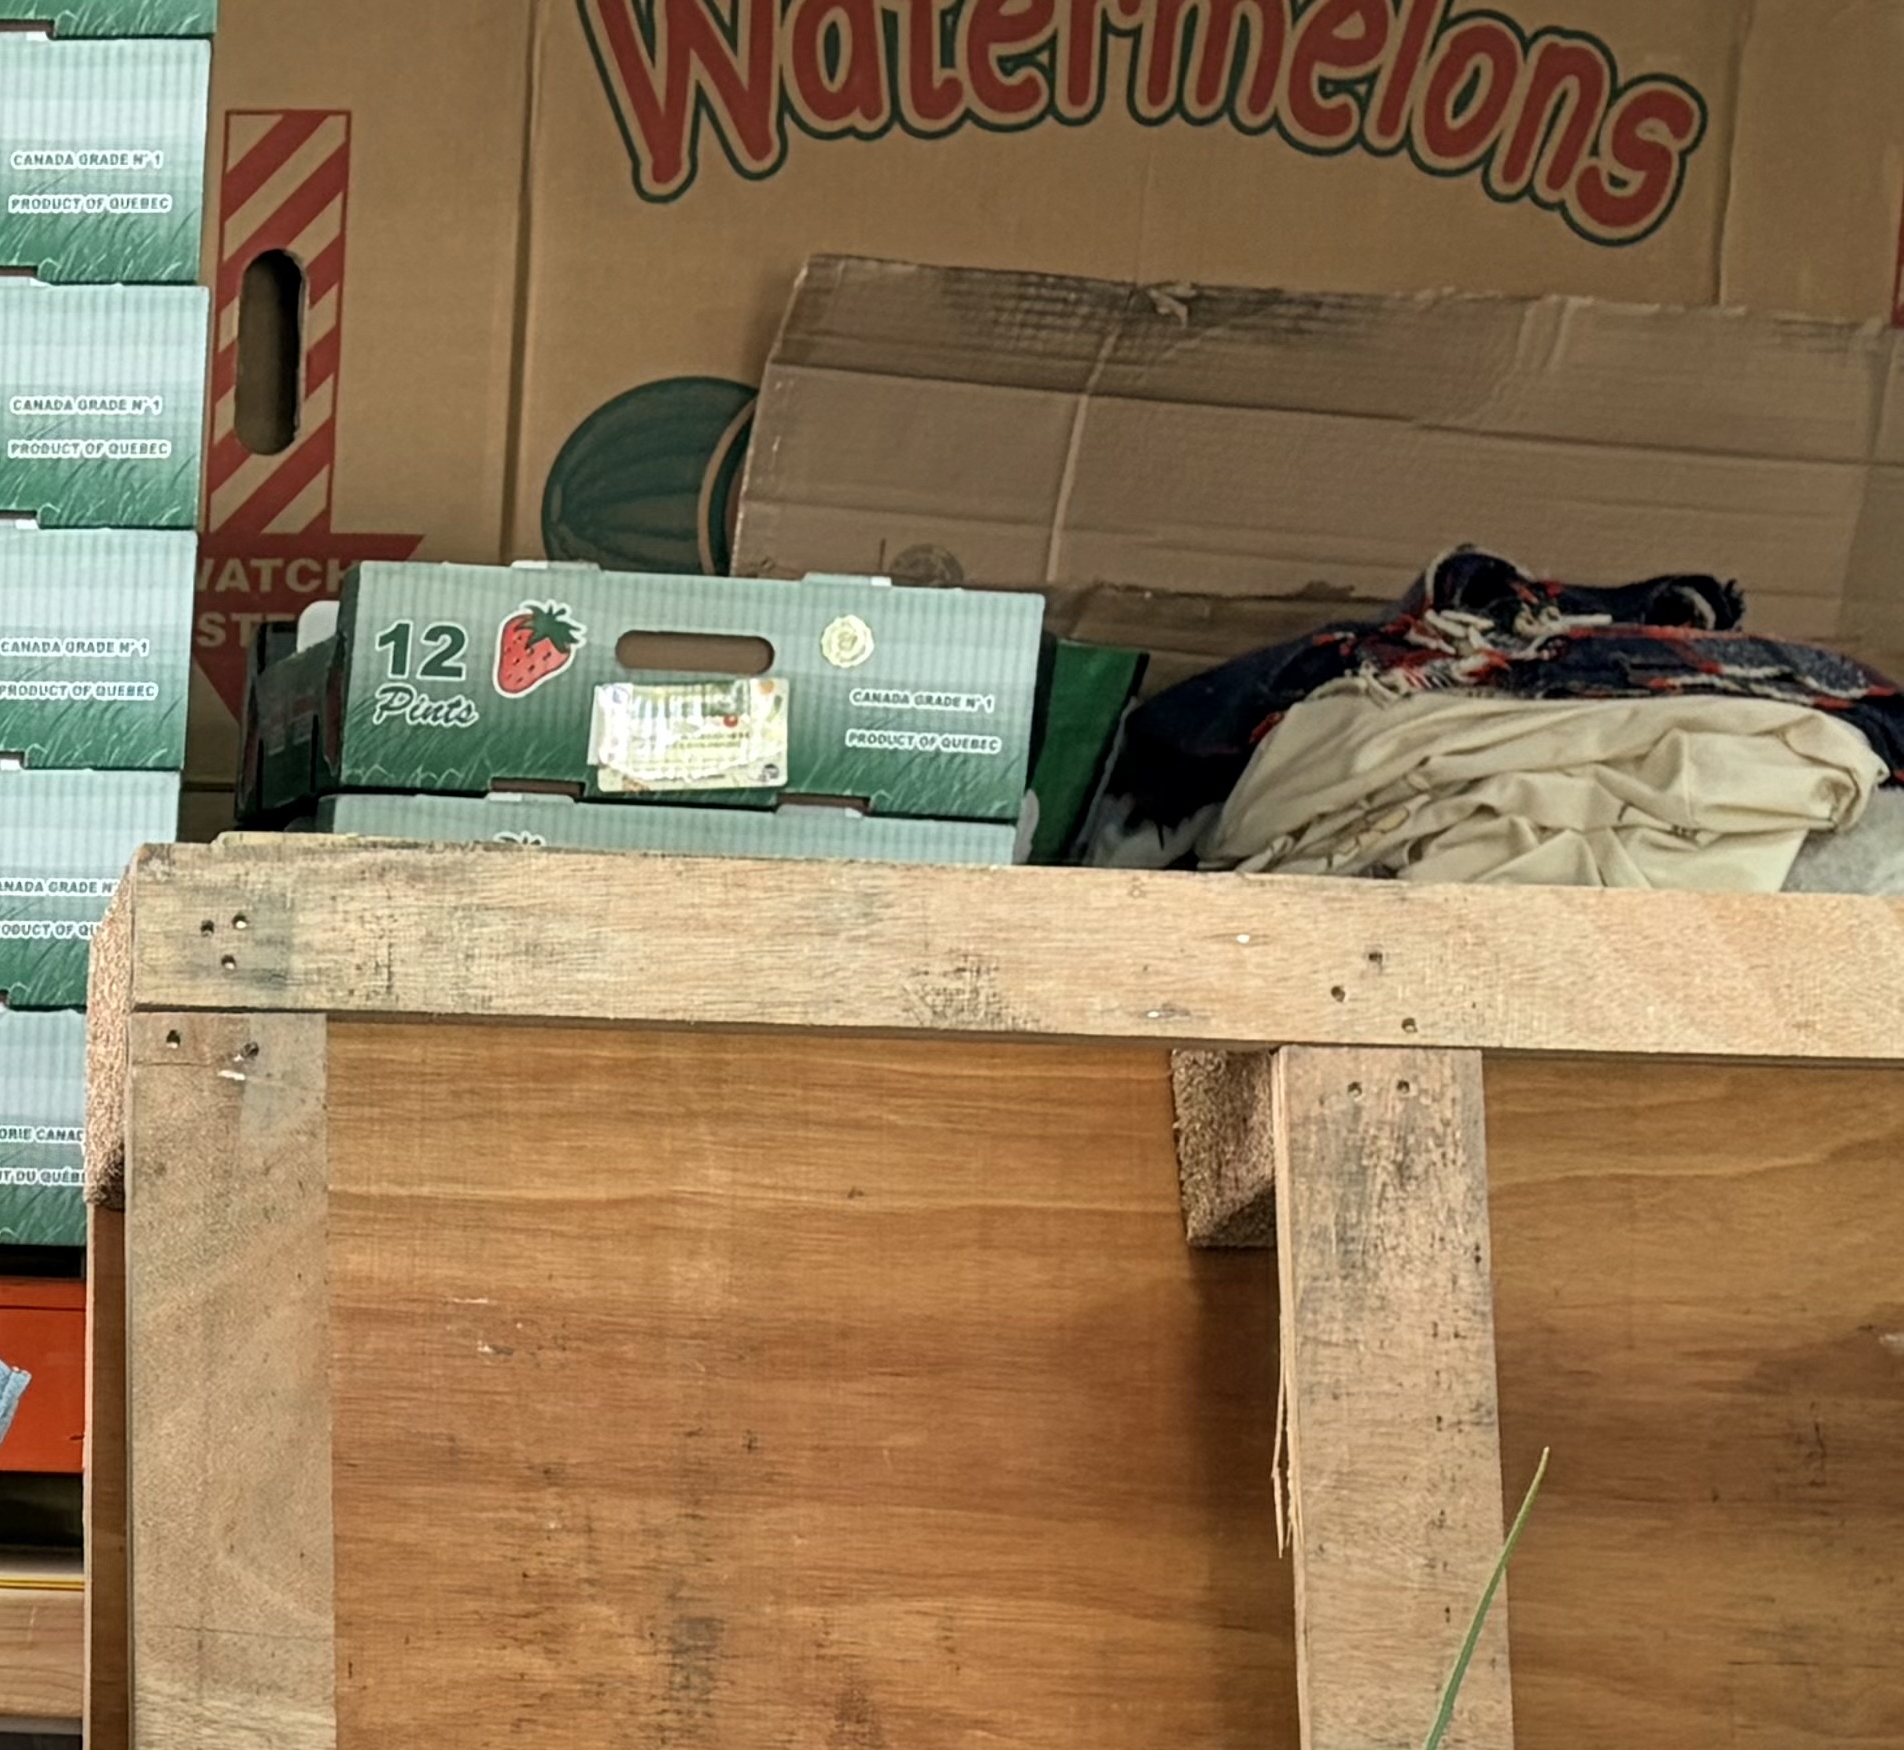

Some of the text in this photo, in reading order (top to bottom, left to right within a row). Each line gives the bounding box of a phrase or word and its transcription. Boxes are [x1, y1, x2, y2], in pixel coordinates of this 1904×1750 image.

[12, 152, 75, 167] CANADA
[78, 152, 130, 167] GRADE
[10, 196, 170, 211] PRODUCT OF QUEBEC
[12, 398, 74, 412] CANADA
[77, 398, 128, 412] GRADE
[10, 441, 169, 456] PRODUCT OF QUEBEC
[0, 640, 61, 654] CANADA
[65, 640, 115, 654] GRADE
[377, 620, 468, 680] 12
[72, 683, 91, 698] OF
[95, 683, 156, 698] QUEBEC
[374, 685, 478, 726] Pints
[852, 690, 910, 705] CANADA
[915, 692, 960, 708] GRADE
[847, 732, 999, 752] PRODUCT OF QUEBEC
[47, 880, 98, 894] GRADE
[54, 923, 73, 937] OF
[36, 1128, 86, 1142] CANAD
[15, 1170, 37, 1183] DU
[40, 1169, 86, 1185] QUÉB
